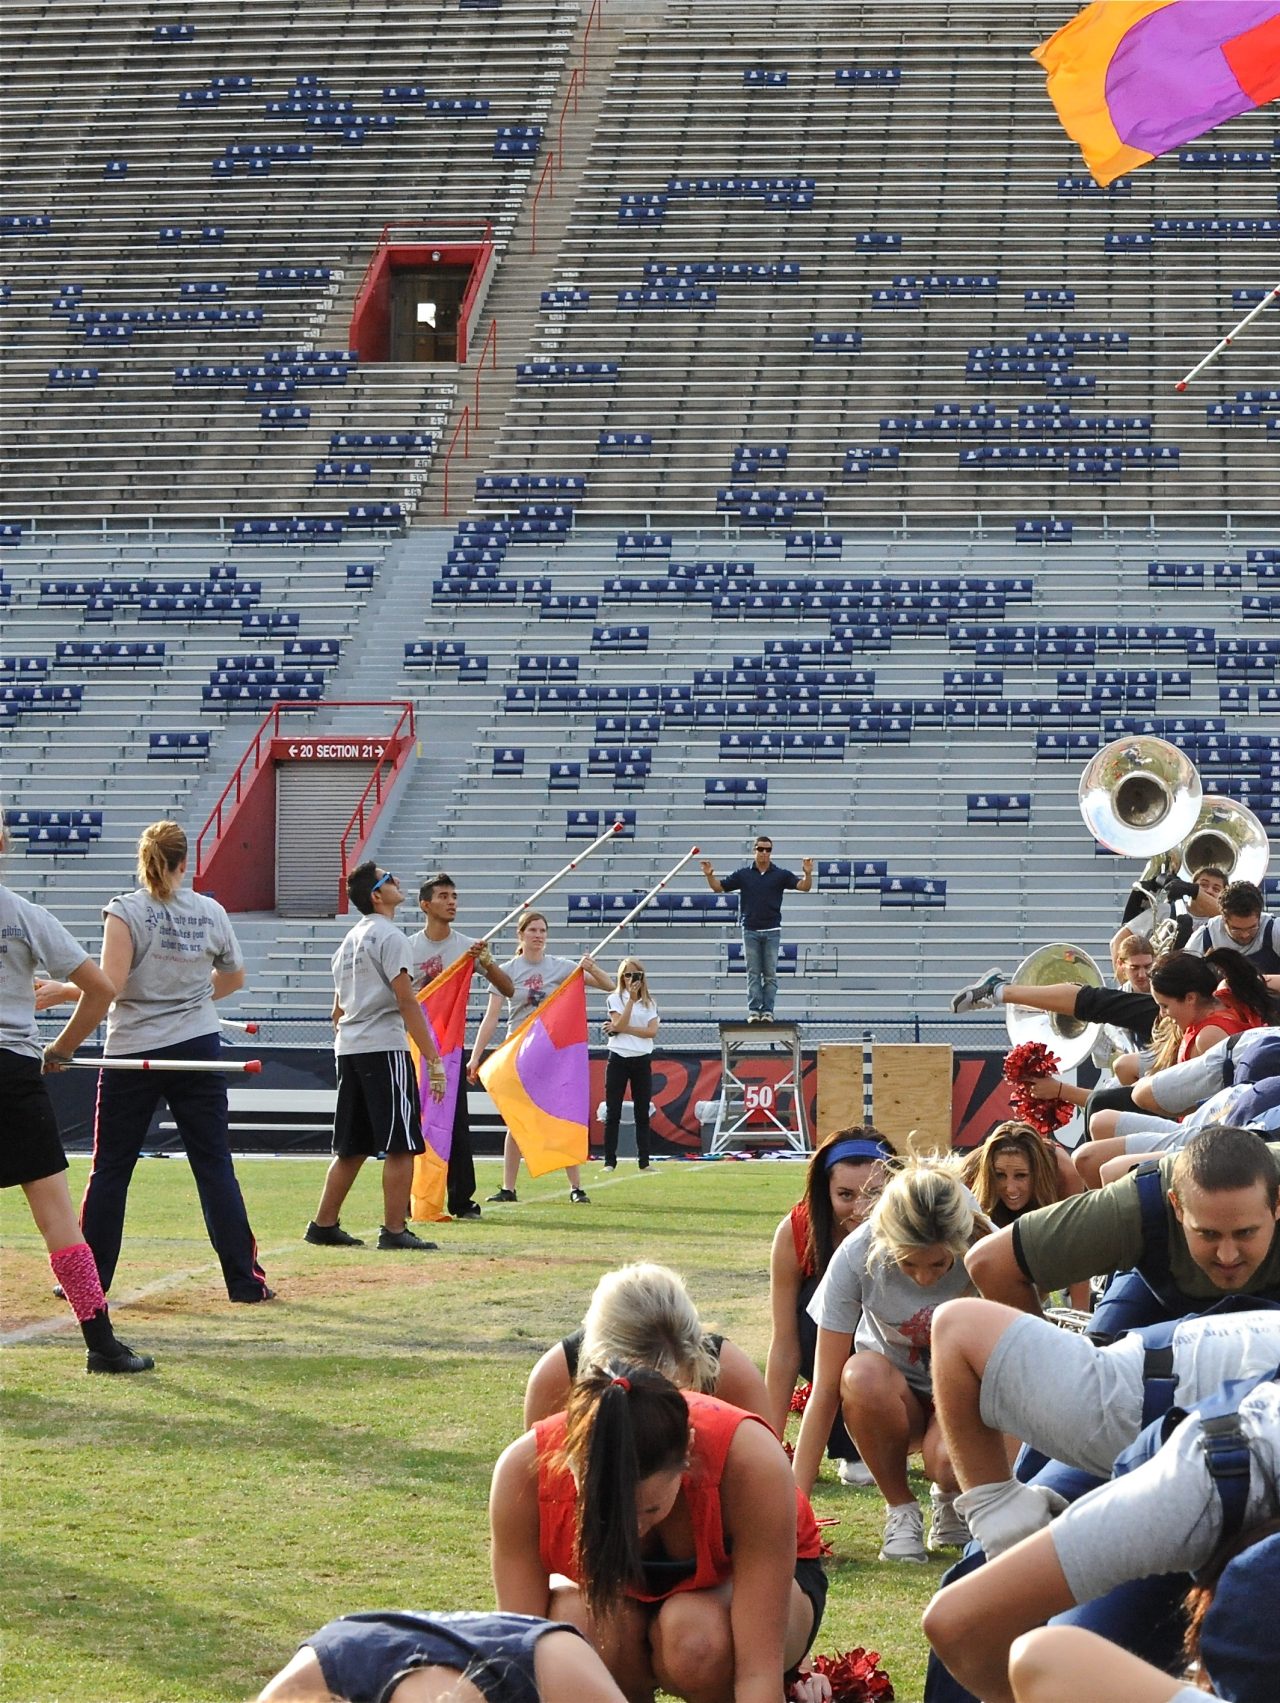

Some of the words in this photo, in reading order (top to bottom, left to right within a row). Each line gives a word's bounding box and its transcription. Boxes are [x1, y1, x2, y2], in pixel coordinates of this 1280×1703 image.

[300, 745, 313, 758] 20
[316, 745, 359, 758] SECTION
[362, 745, 373, 758] 21
[745, 1086, 773, 1109] 50
